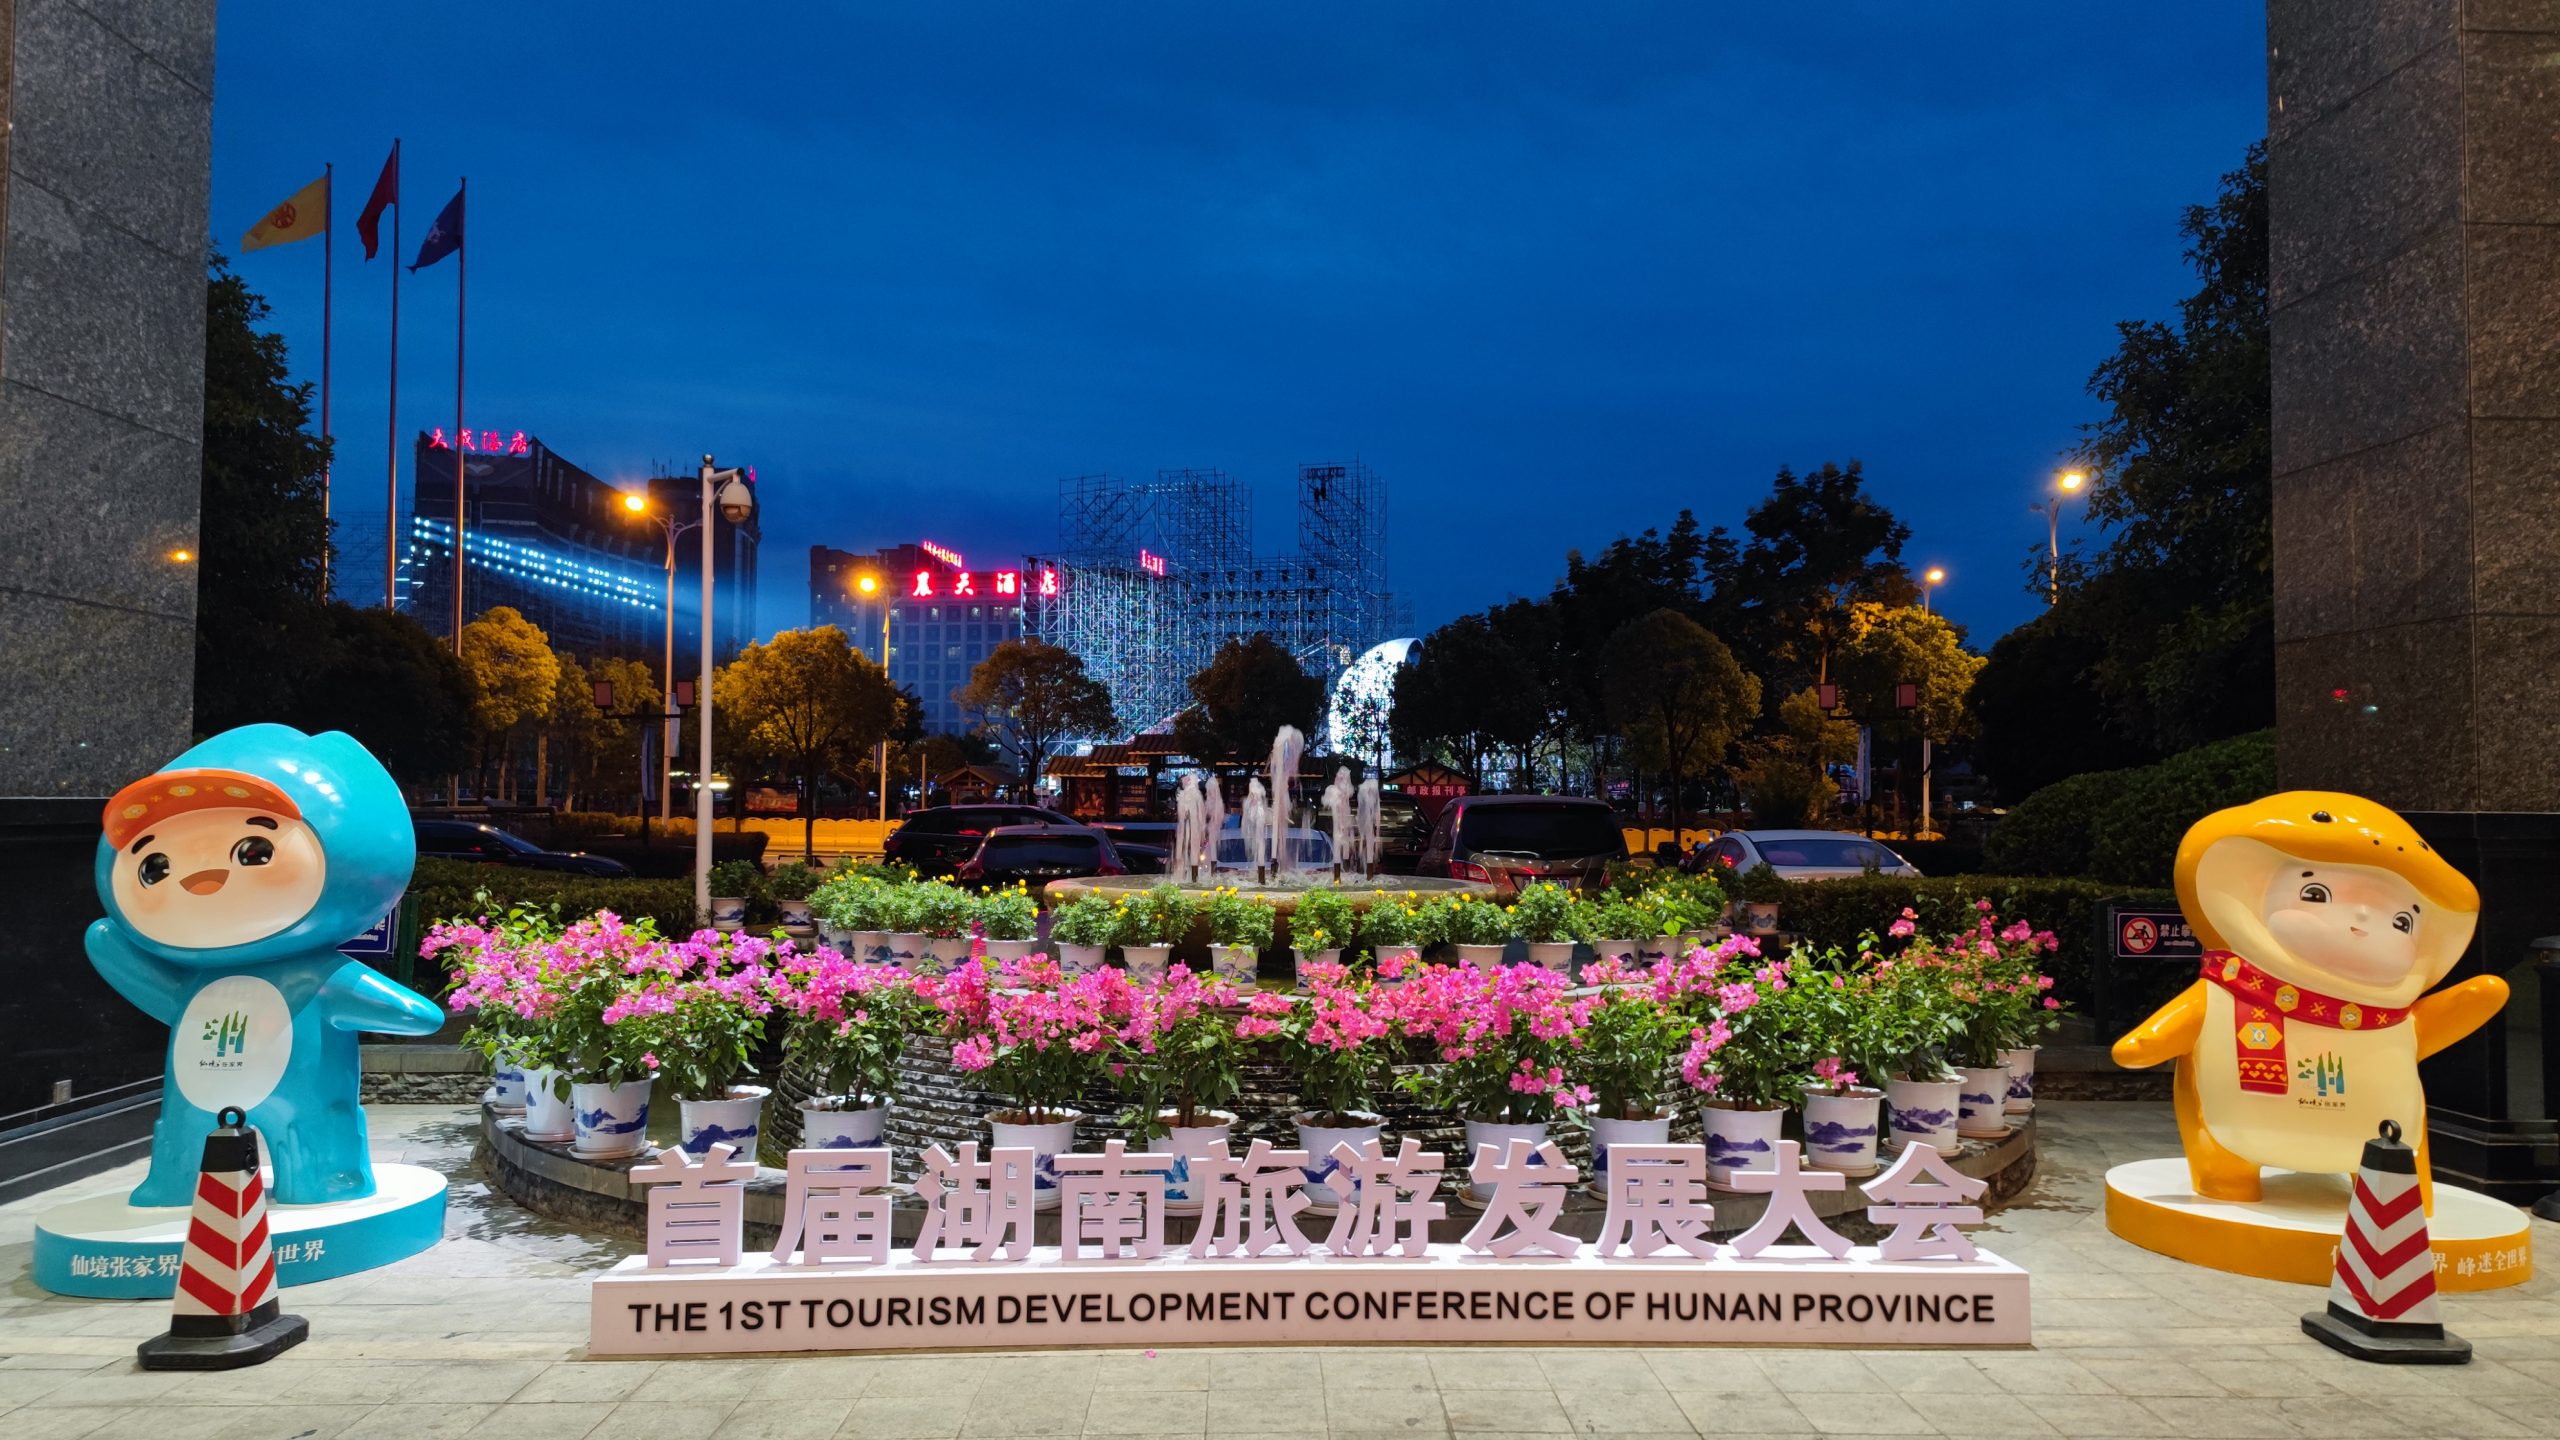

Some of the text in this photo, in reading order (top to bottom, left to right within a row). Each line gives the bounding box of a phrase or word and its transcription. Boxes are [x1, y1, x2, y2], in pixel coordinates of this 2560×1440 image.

[629, 1137, 1990, 1268] 首届湖南旅游发展大会
[70, 1253, 180, 1279] 仙境张家界
[2457, 1246, 2528, 1278] 峰迷全世界
[627, 1291, 1995, 1333] THE 1ST TOURISM DEVELOPMENT CONFERENCE OF HUNAN PROVINCE
